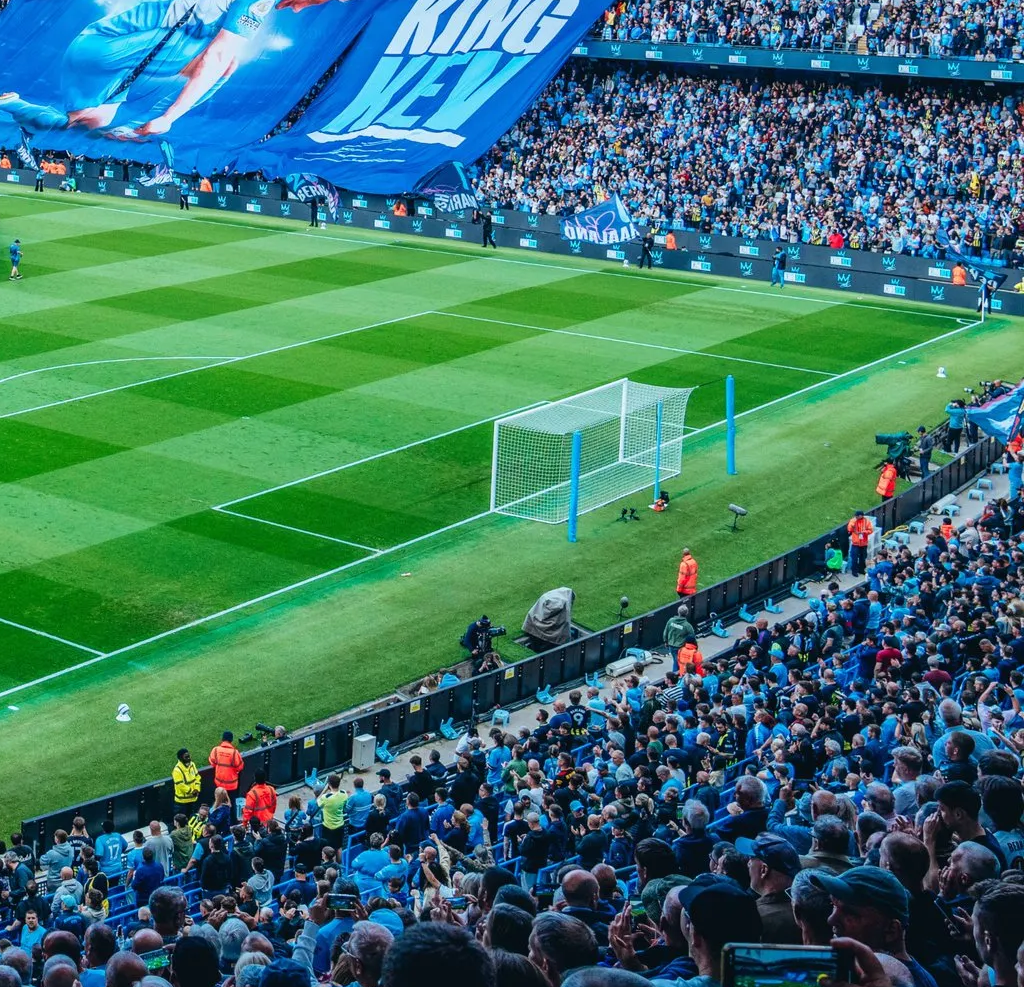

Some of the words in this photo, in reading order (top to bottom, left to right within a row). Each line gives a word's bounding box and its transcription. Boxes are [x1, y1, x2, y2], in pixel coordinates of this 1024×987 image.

[322, 50, 536, 133] KEV
[573, 713, 583, 725] 9
[108, 844, 120, 860] 17
